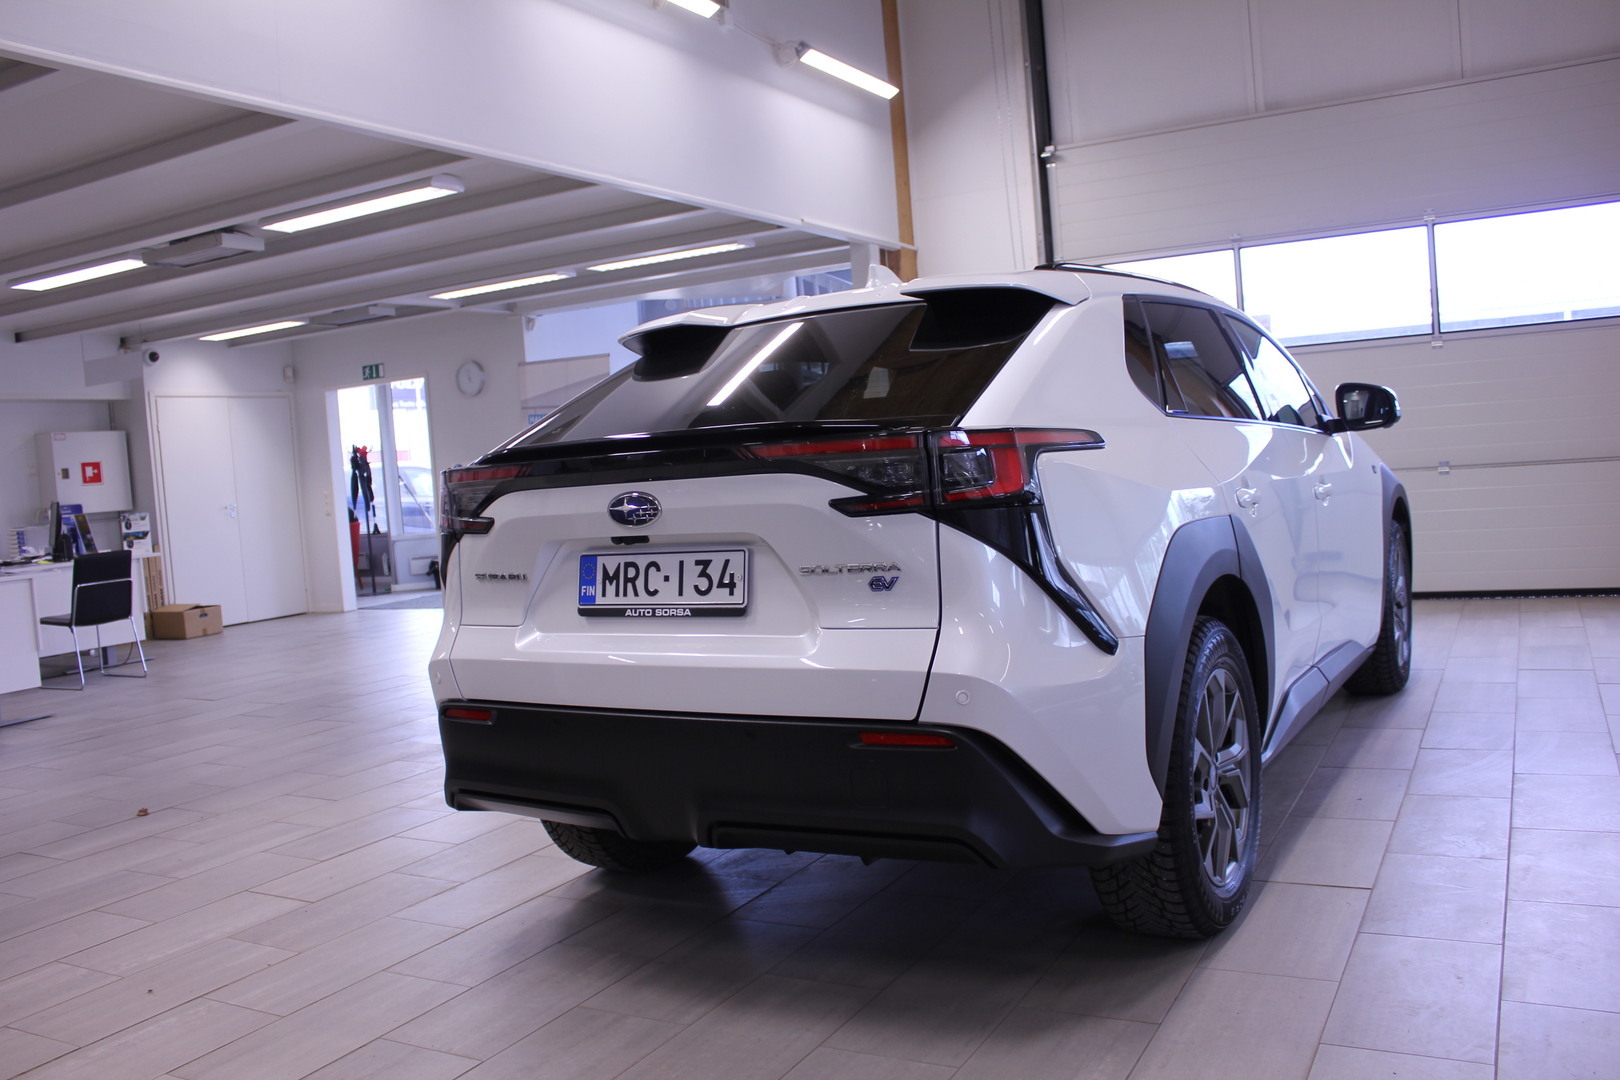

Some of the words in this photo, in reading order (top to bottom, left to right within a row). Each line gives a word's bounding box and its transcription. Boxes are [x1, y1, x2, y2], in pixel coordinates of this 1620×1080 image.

[799, 562, 902, 576] SOLTERRA
[867, 575, 900, 593] EV
[581, 585, 596, 597] FIN
[625, 608, 653, 617] AUTO
[655, 608, 692, 617] SORSA
